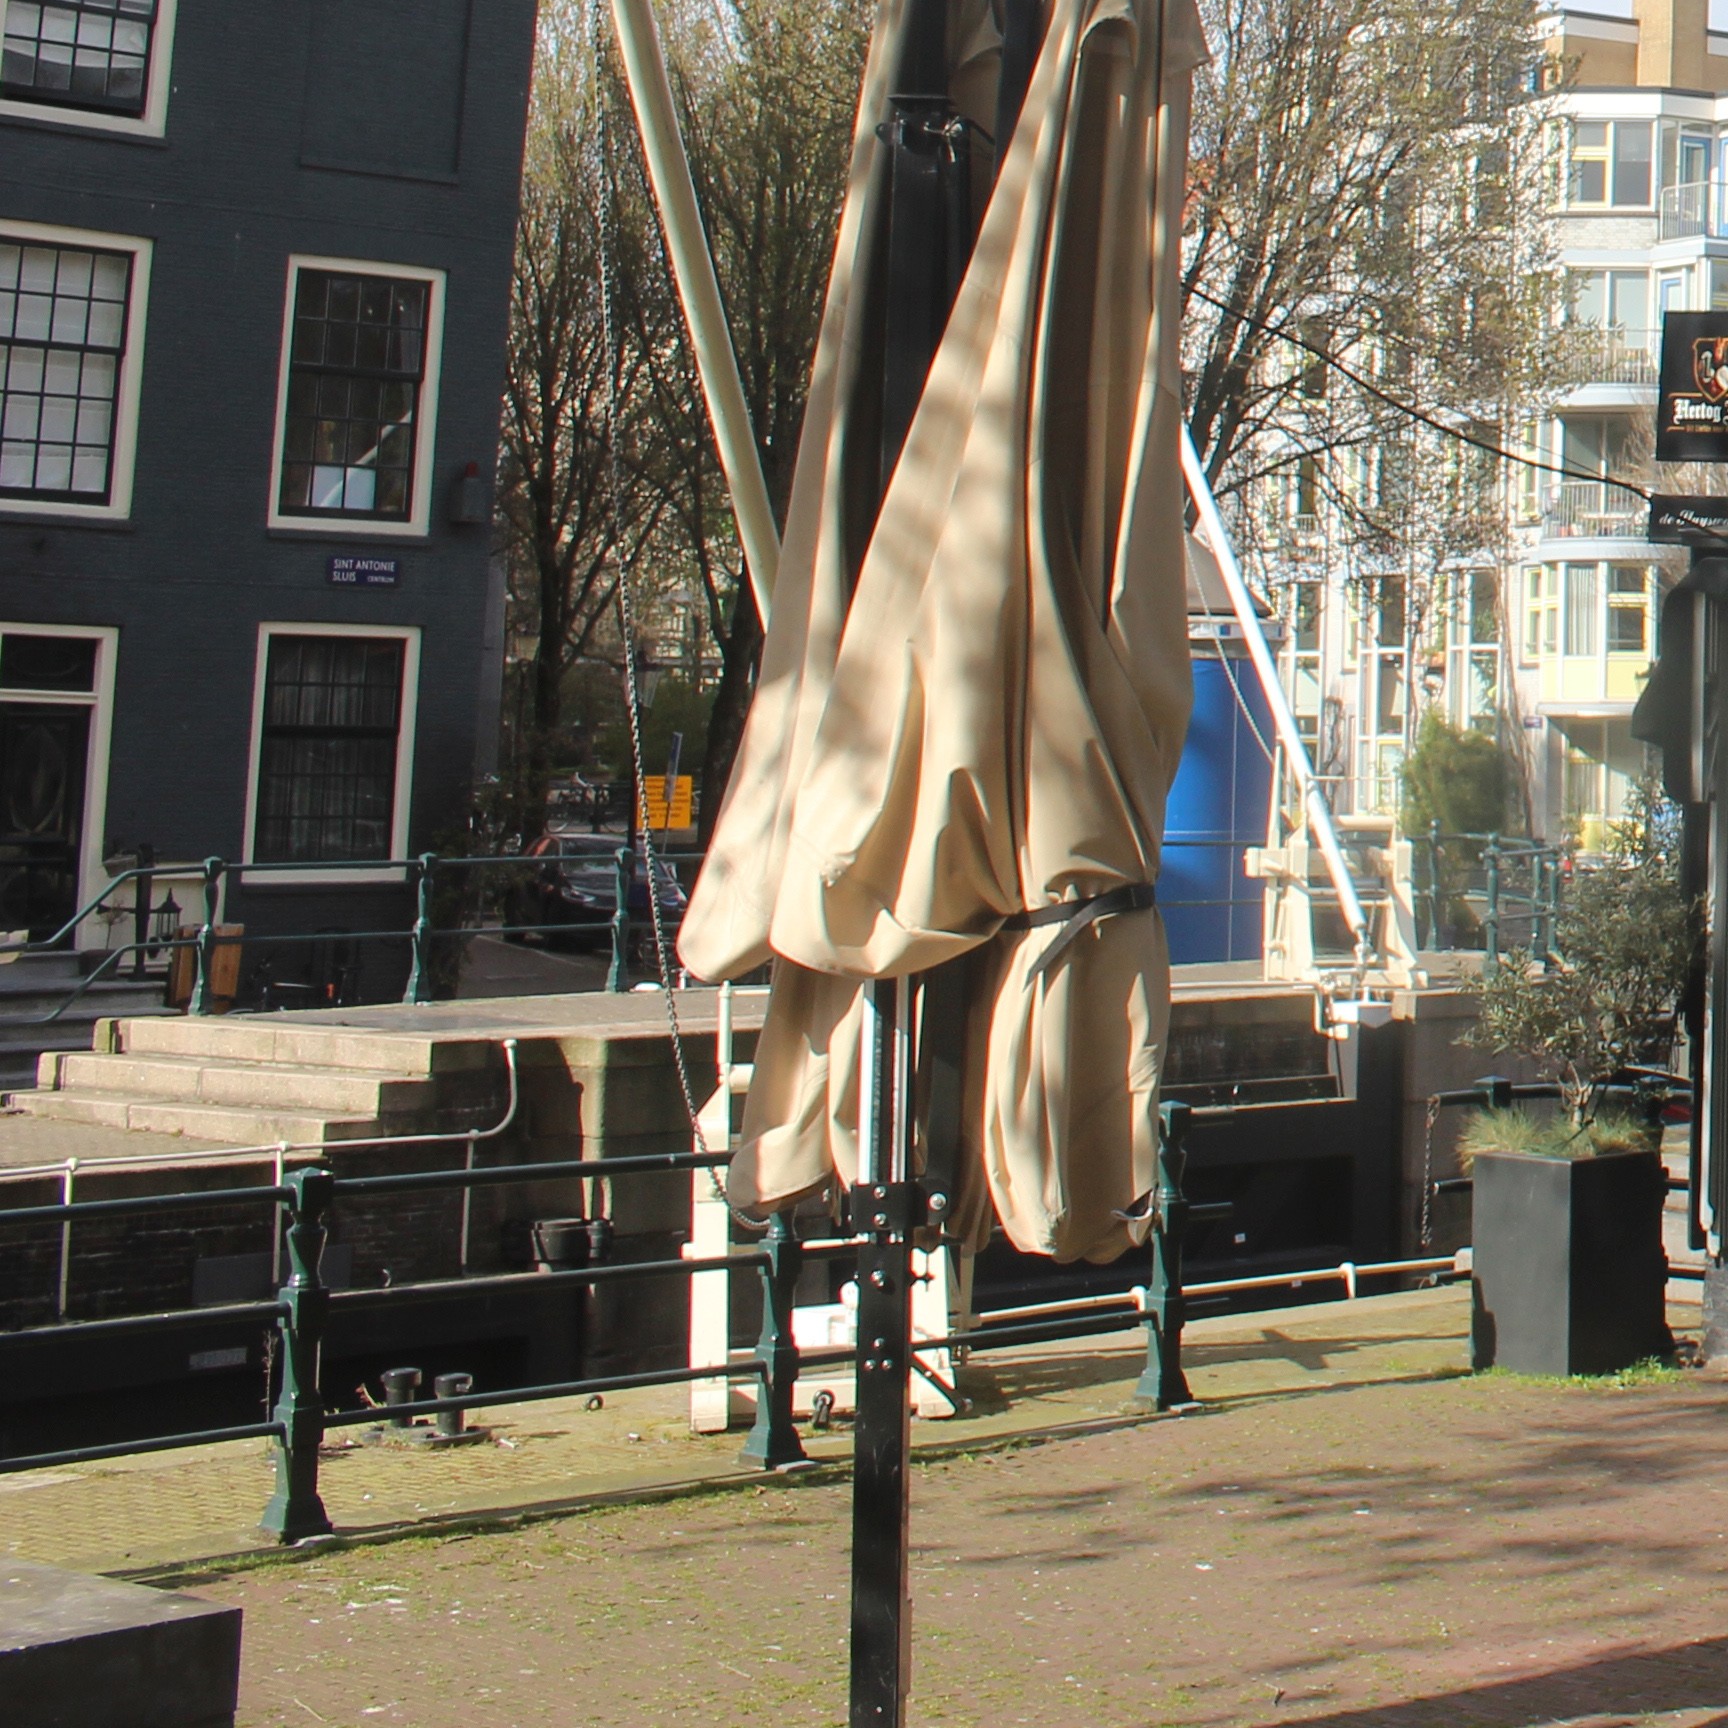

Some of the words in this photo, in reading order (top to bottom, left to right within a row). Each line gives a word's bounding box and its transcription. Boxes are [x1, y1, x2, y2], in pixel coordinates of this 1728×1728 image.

[1673, 398, 1722, 425] Hertog
[333, 559, 354, 570] SINT
[355, 560, 396, 572] ANTONIE
[332, 571, 357, 582] SLUIS
